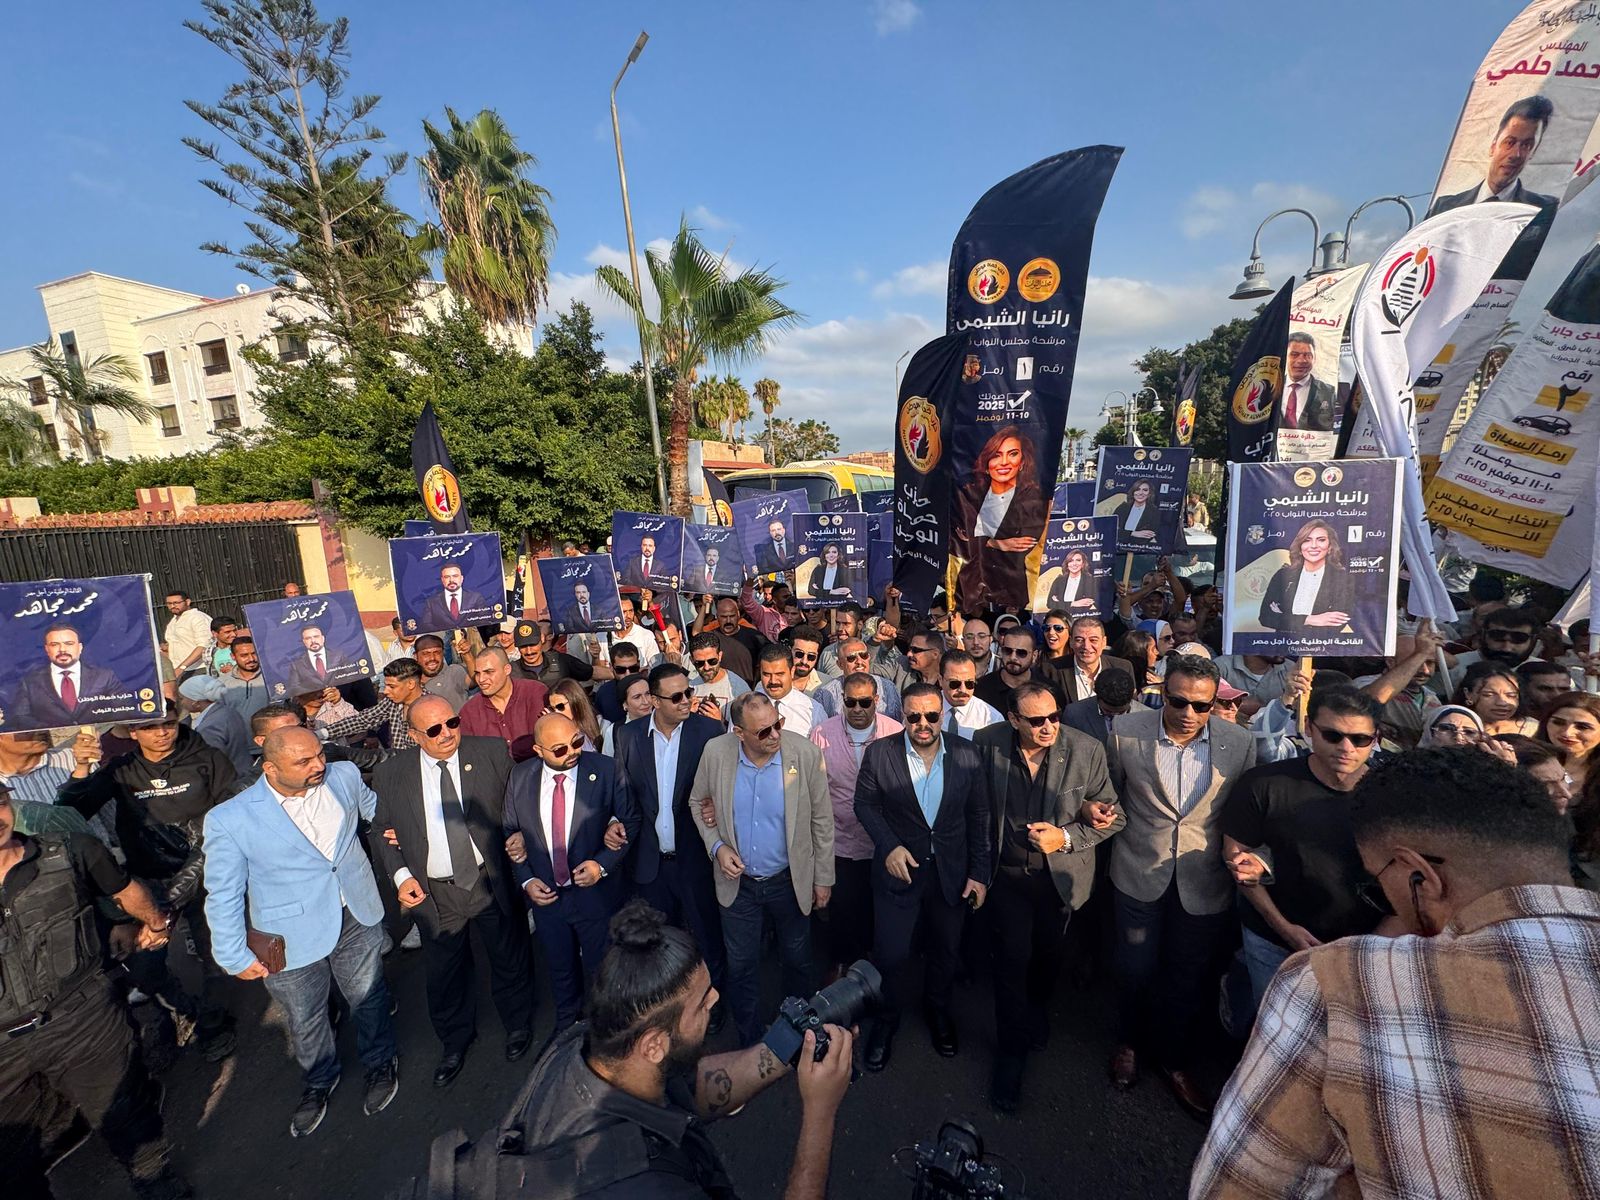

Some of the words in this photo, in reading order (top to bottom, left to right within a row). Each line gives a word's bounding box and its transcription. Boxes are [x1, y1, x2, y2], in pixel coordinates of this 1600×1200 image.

[1539, 41, 1588, 54] المهندس
[1486, 55, 1552, 86] حلمي
[1555, 60, 1600, 79] حمد
[1032, 310, 1070, 328] رانيا
[1288, 311, 1305, 322] حلم
[1308, 313, 1342, 328] أحمد
[1550, 326, 1573, 339] جابر
[973, 338, 999, 347] النواب
[1000, 337, 1030, 347] مجلس
[1032, 336, 1066, 346] مرشحة
[1039, 364, 1064, 375] رقم
[1561, 370, 1593, 383] رقم
[1557, 384, 1582, 412] ٢
[978, 401, 1005, 410] 2025
[975, 413, 1005, 422] نوفمبر
[1245, 432, 1274, 456] حزب
[1490, 429, 1539, 452] السيارة
[1115, 462, 1153, 474] الشيمي
[1155, 463, 1175, 472] رانيا
[1465, 456, 1488, 472] ٢٠٢٥
[1487, 467, 1528, 485] نوفمبر
[904, 483, 931, 508] حزب
[1264, 490, 1330, 510] الشيمي
[1335, 491, 1369, 505] رانيا
[1435, 491, 1479, 512] مجلس
[755, 504, 775, 519] مجاهد
[774, 499, 788, 514] محمد
[897, 497, 938, 526] حماة
[1336, 509, 1367, 517] مرشحة
[1428, 500, 1452, 515] ٢٠٢٥
[1282, 510, 1305, 518] النواب
[1306, 510, 1335, 518] مجلس
[1480, 505, 1549, 528] انتخابات
[632, 520, 652, 532] مجاهد
[650, 521, 666, 532] محمد
[804, 527, 837, 538] الشيمي
[840, 527, 856, 535] رانيا
[698, 532, 718, 542] مجاهد
[715, 532, 730, 543] محمد
[1046, 533, 1083, 545] الشيمي
[1085, 533, 1104, 541] رانيا
[1365, 529, 1386, 539] رقم
[422, 546, 453, 560] مجاهد
[452, 542, 473, 557] محمد
[561, 567, 580, 578] مجاهد
[580, 563, 592, 577] محمد
[14, 598, 64, 618] مجاهد
[62, 591, 98, 615] محمد
[281, 607, 310, 623] مجاهد
[310, 601, 328, 619] محمد
[1270, 637, 1285, 646] أجل
[1301, 638, 1333, 646] الوطنية
[1334, 638, 1364, 646] القائمة
